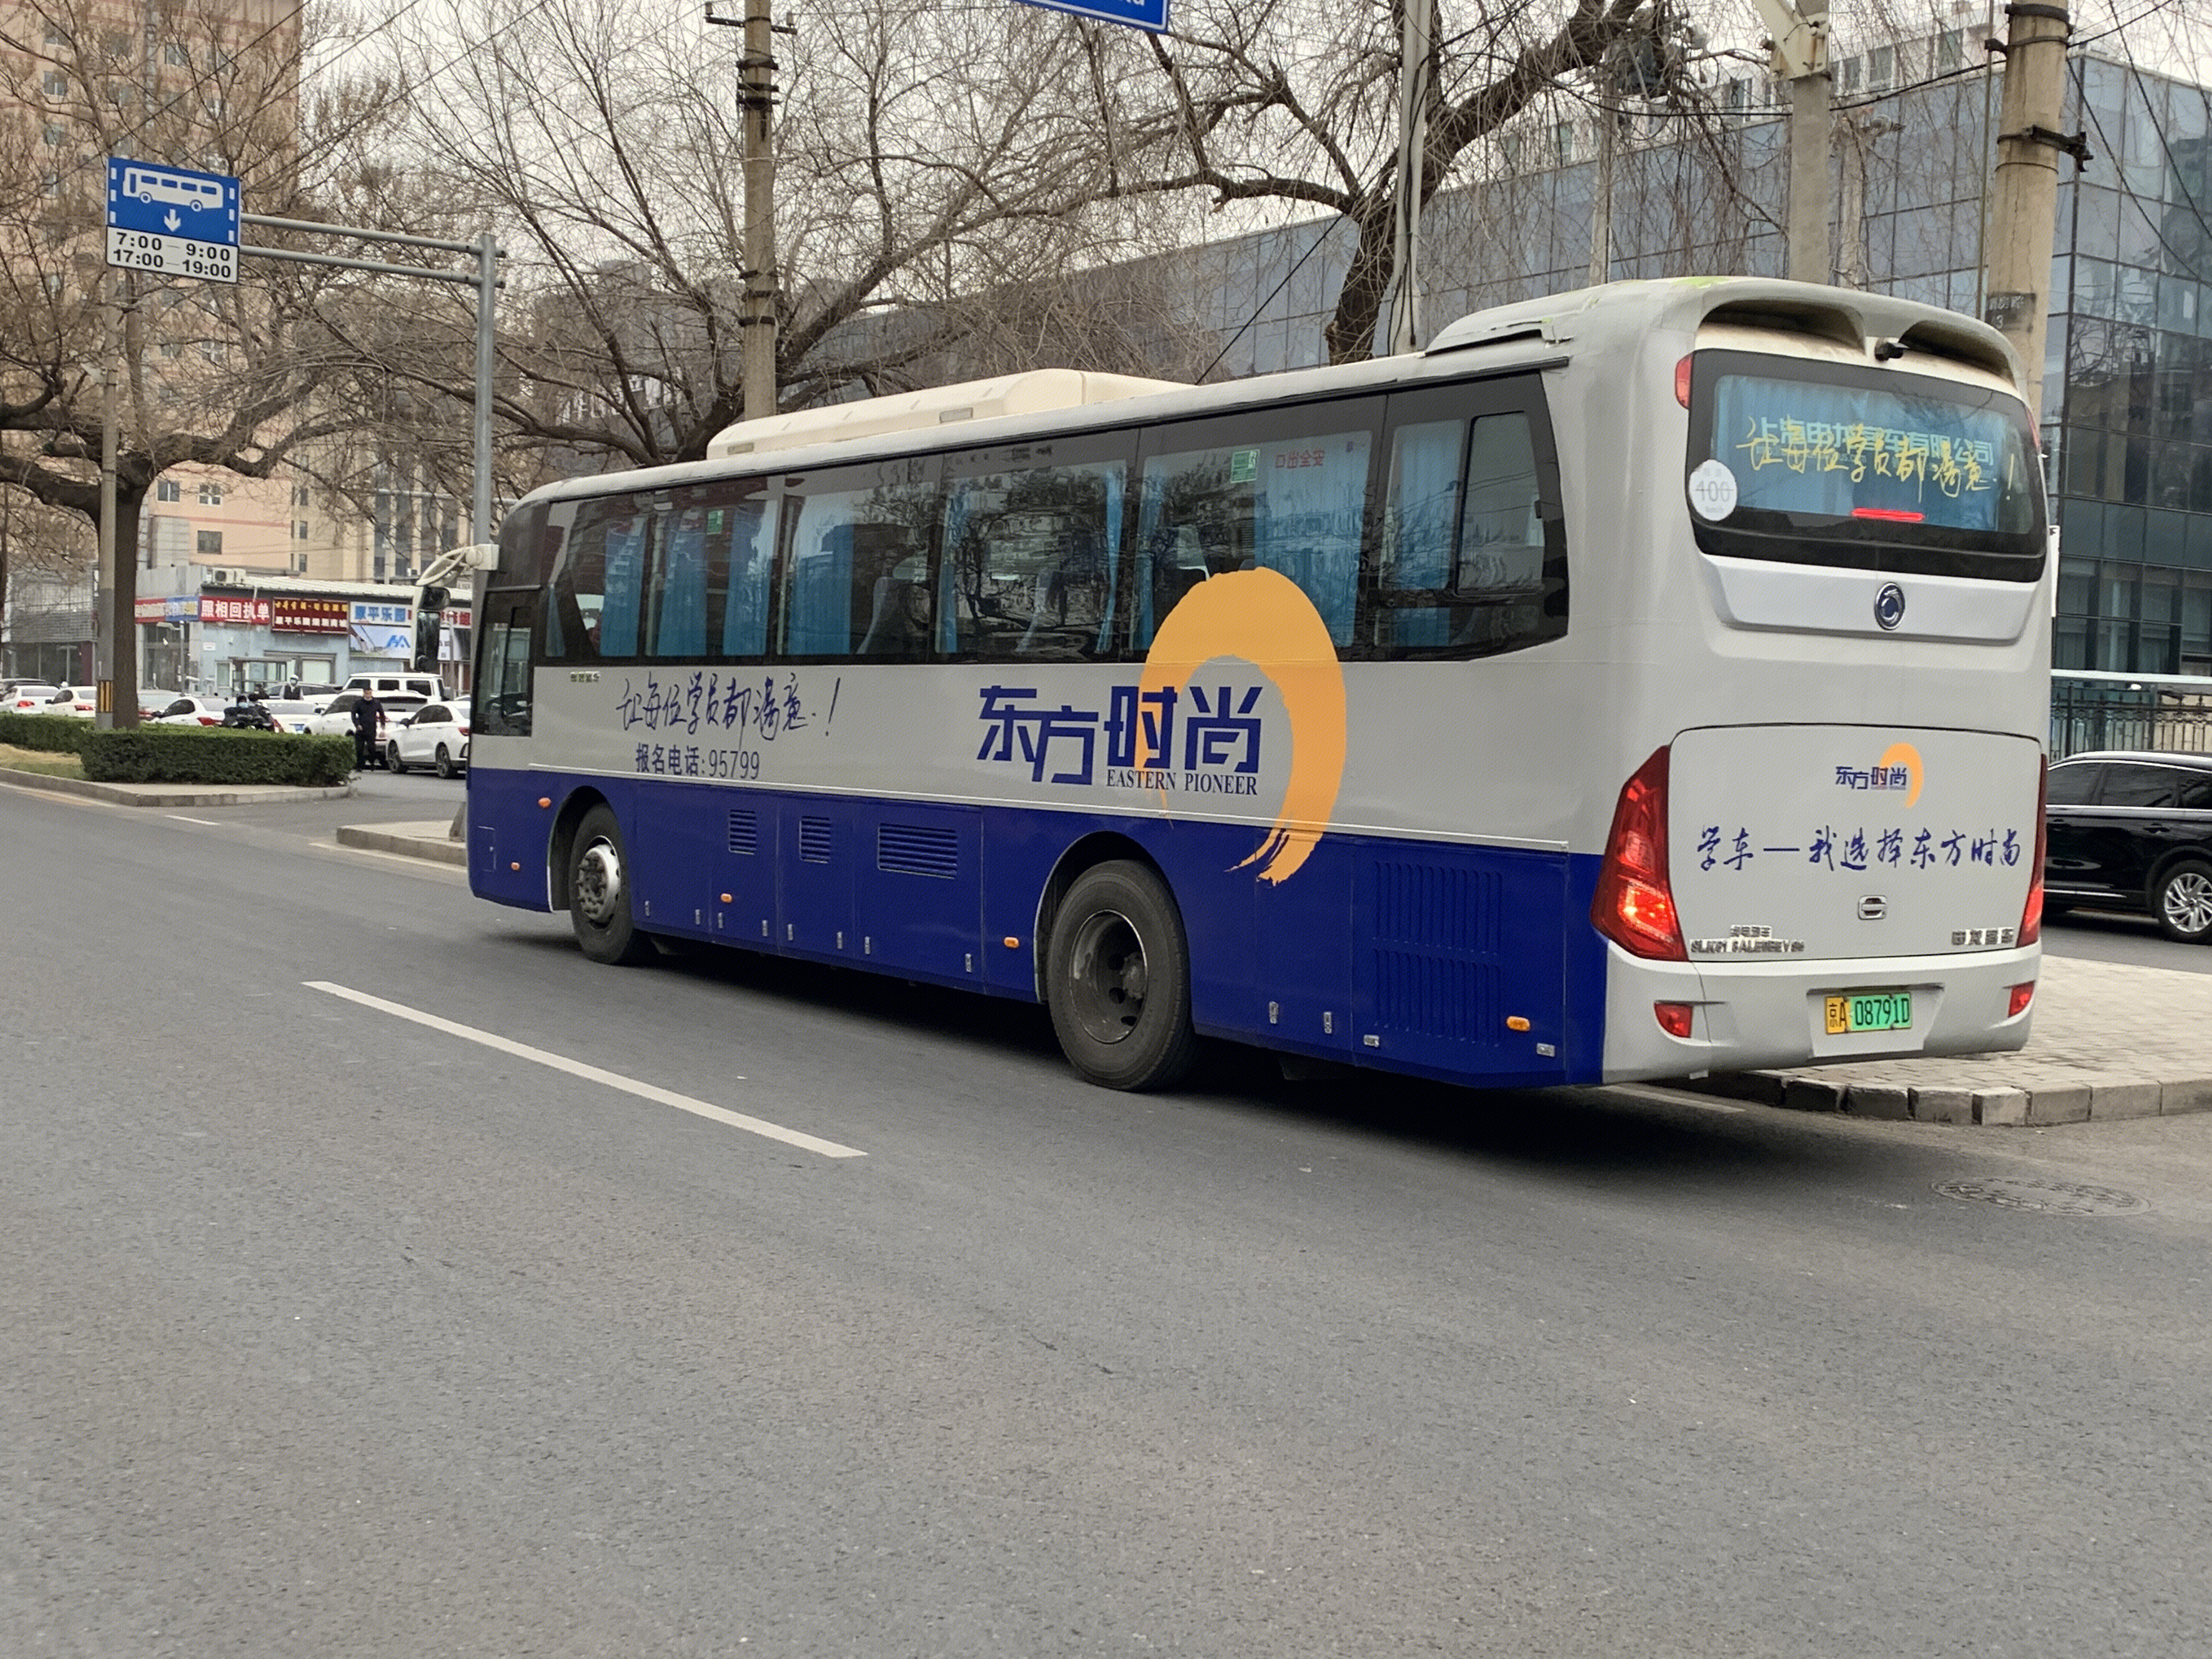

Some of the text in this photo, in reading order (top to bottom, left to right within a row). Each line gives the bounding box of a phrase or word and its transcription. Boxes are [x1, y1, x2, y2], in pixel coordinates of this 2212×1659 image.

[116, 232, 162, 251] 7:00
[185, 243, 230, 261] 9:00
[114, 249, 163, 267] 17:00
[182, 259, 231, 278] 19:00
[201, 600, 269, 620] 照相回执单
[977, 685, 1263, 785] 东方时尚
[1107, 769, 1258, 795] EASTERN PIONEER
[1835, 766, 1907, 789] 东方时尚
[1855, 998, 1910, 1026] 08791D
